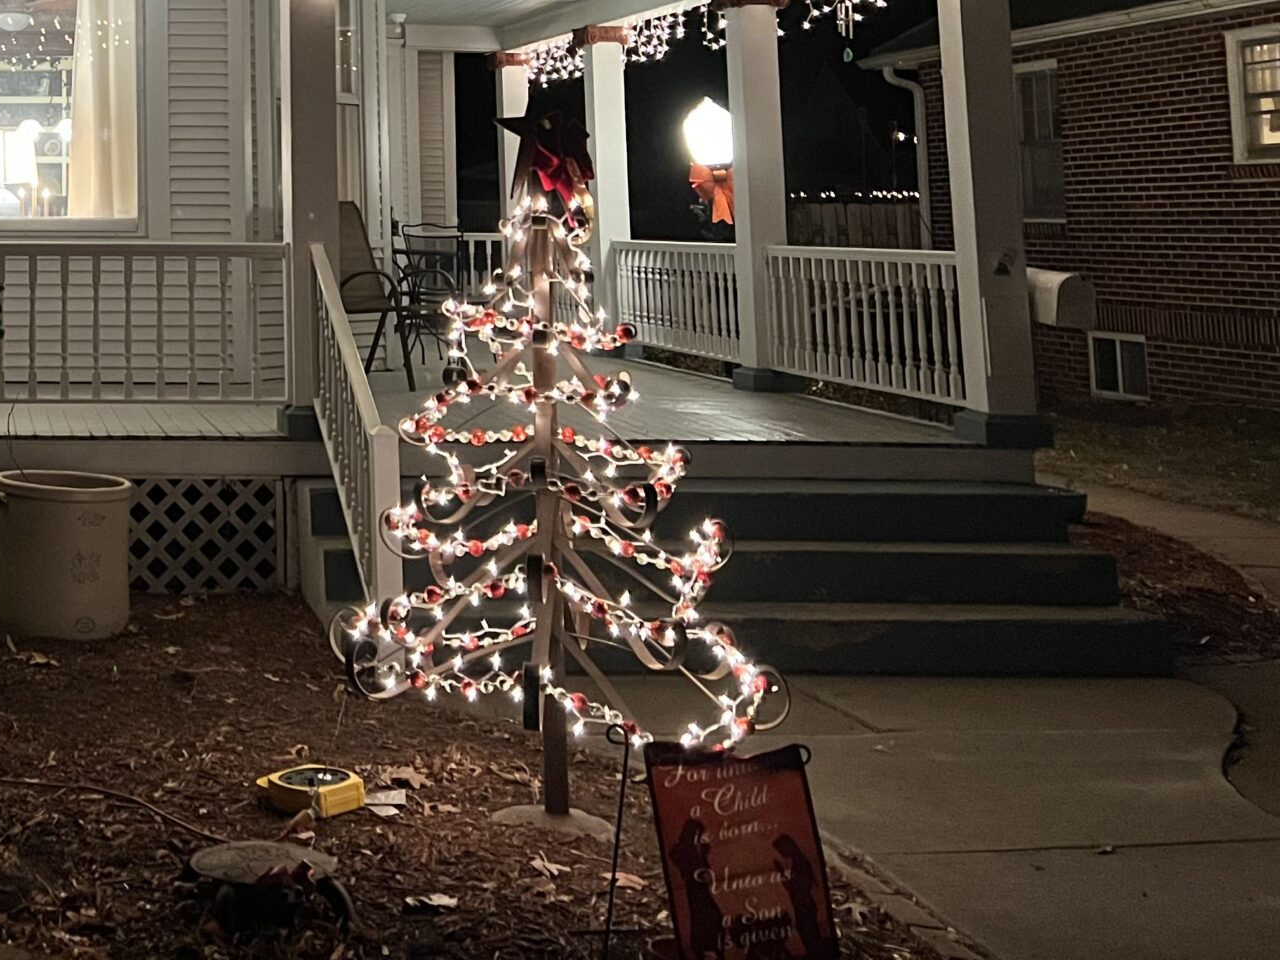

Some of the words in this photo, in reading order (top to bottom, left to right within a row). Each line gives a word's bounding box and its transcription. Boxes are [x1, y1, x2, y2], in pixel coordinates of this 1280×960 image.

[658, 764, 709, 788] For
[690, 805, 701, 818] a
[701, 783, 767, 816] Child
[694, 866, 763, 894] Unto
[770, 869, 791, 884] us
[721, 914, 732, 928] a
[741, 897, 781, 924] Son
[740, 925, 792, 954] given
